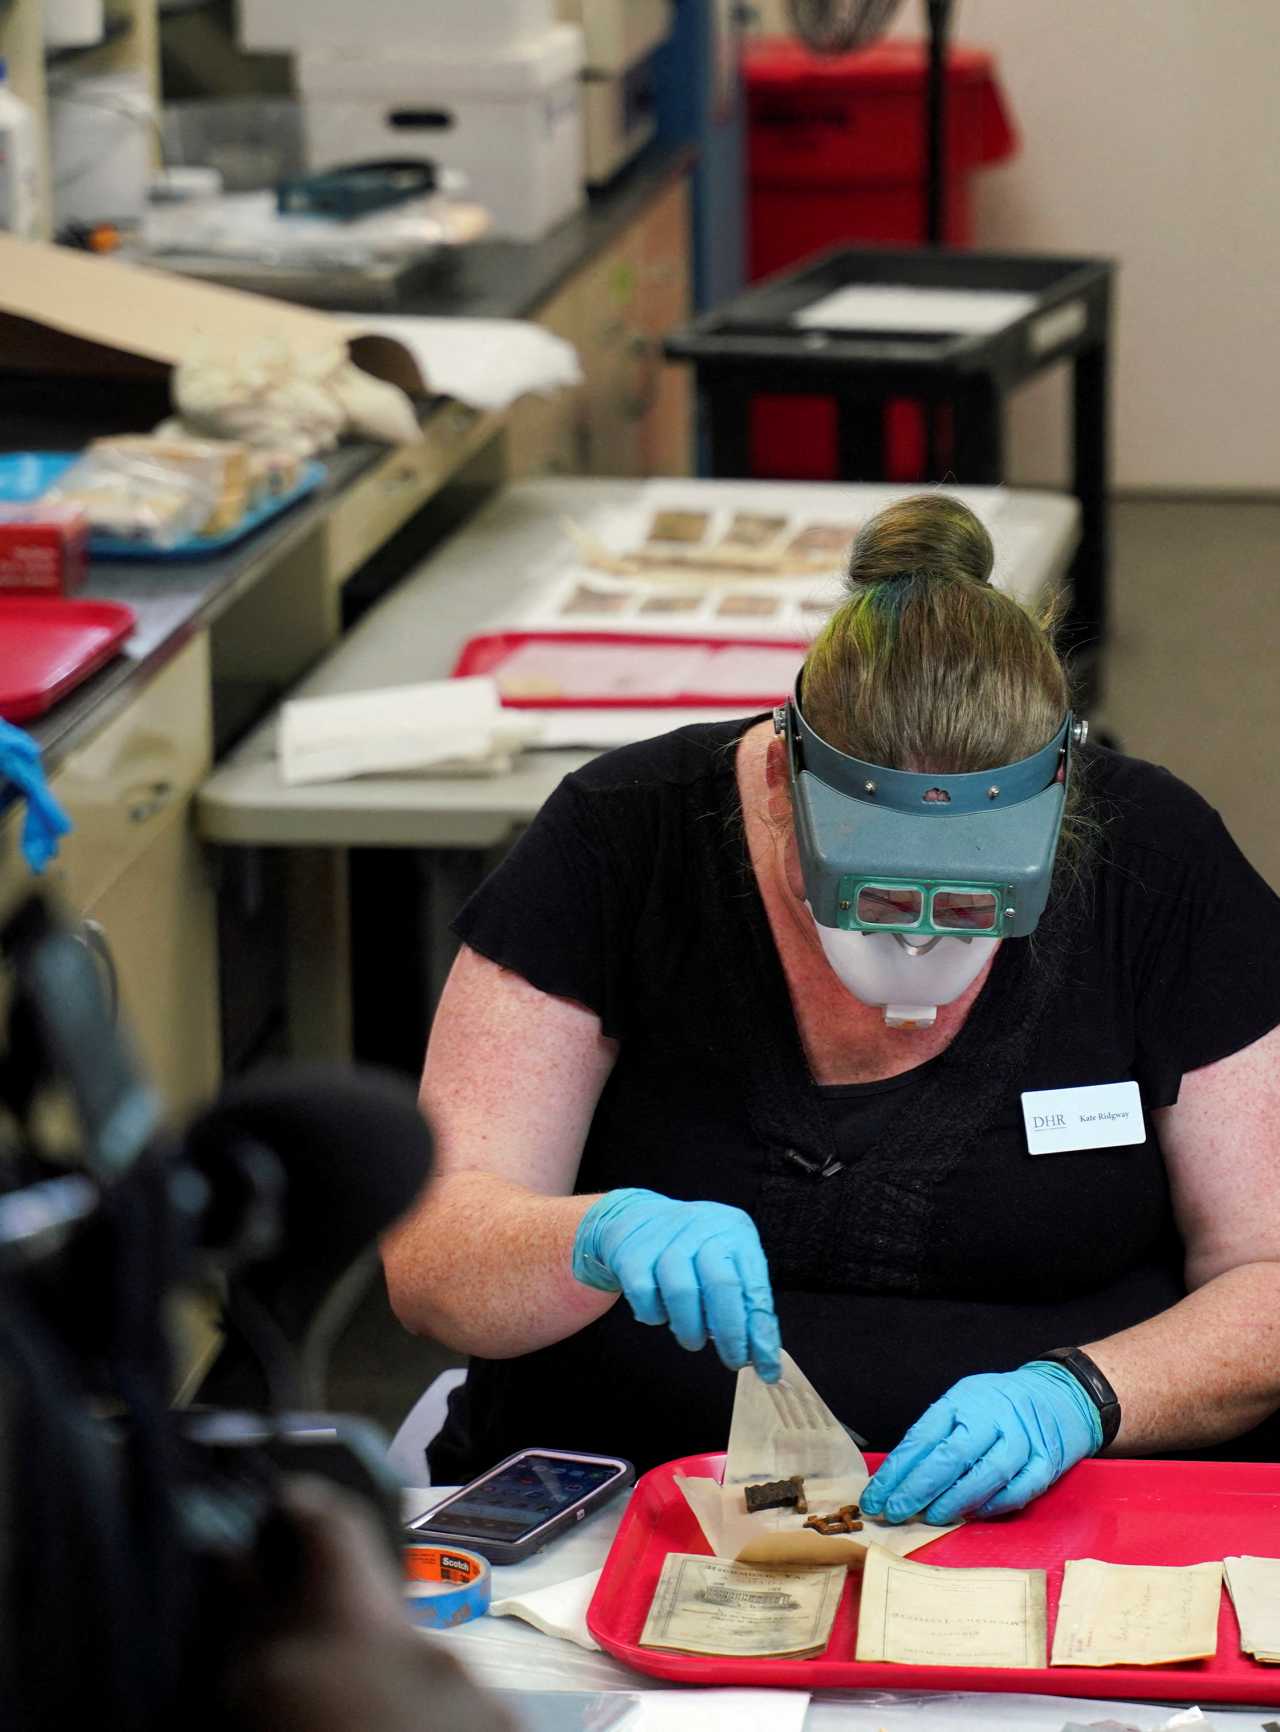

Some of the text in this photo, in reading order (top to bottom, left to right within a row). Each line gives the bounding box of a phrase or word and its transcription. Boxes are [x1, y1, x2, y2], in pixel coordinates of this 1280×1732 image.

[1033, 1114, 1066, 1128] DHR
[1079, 1111, 1130, 1123] Kate Ridgway
[442, 1556, 470, 1572] Scotch
